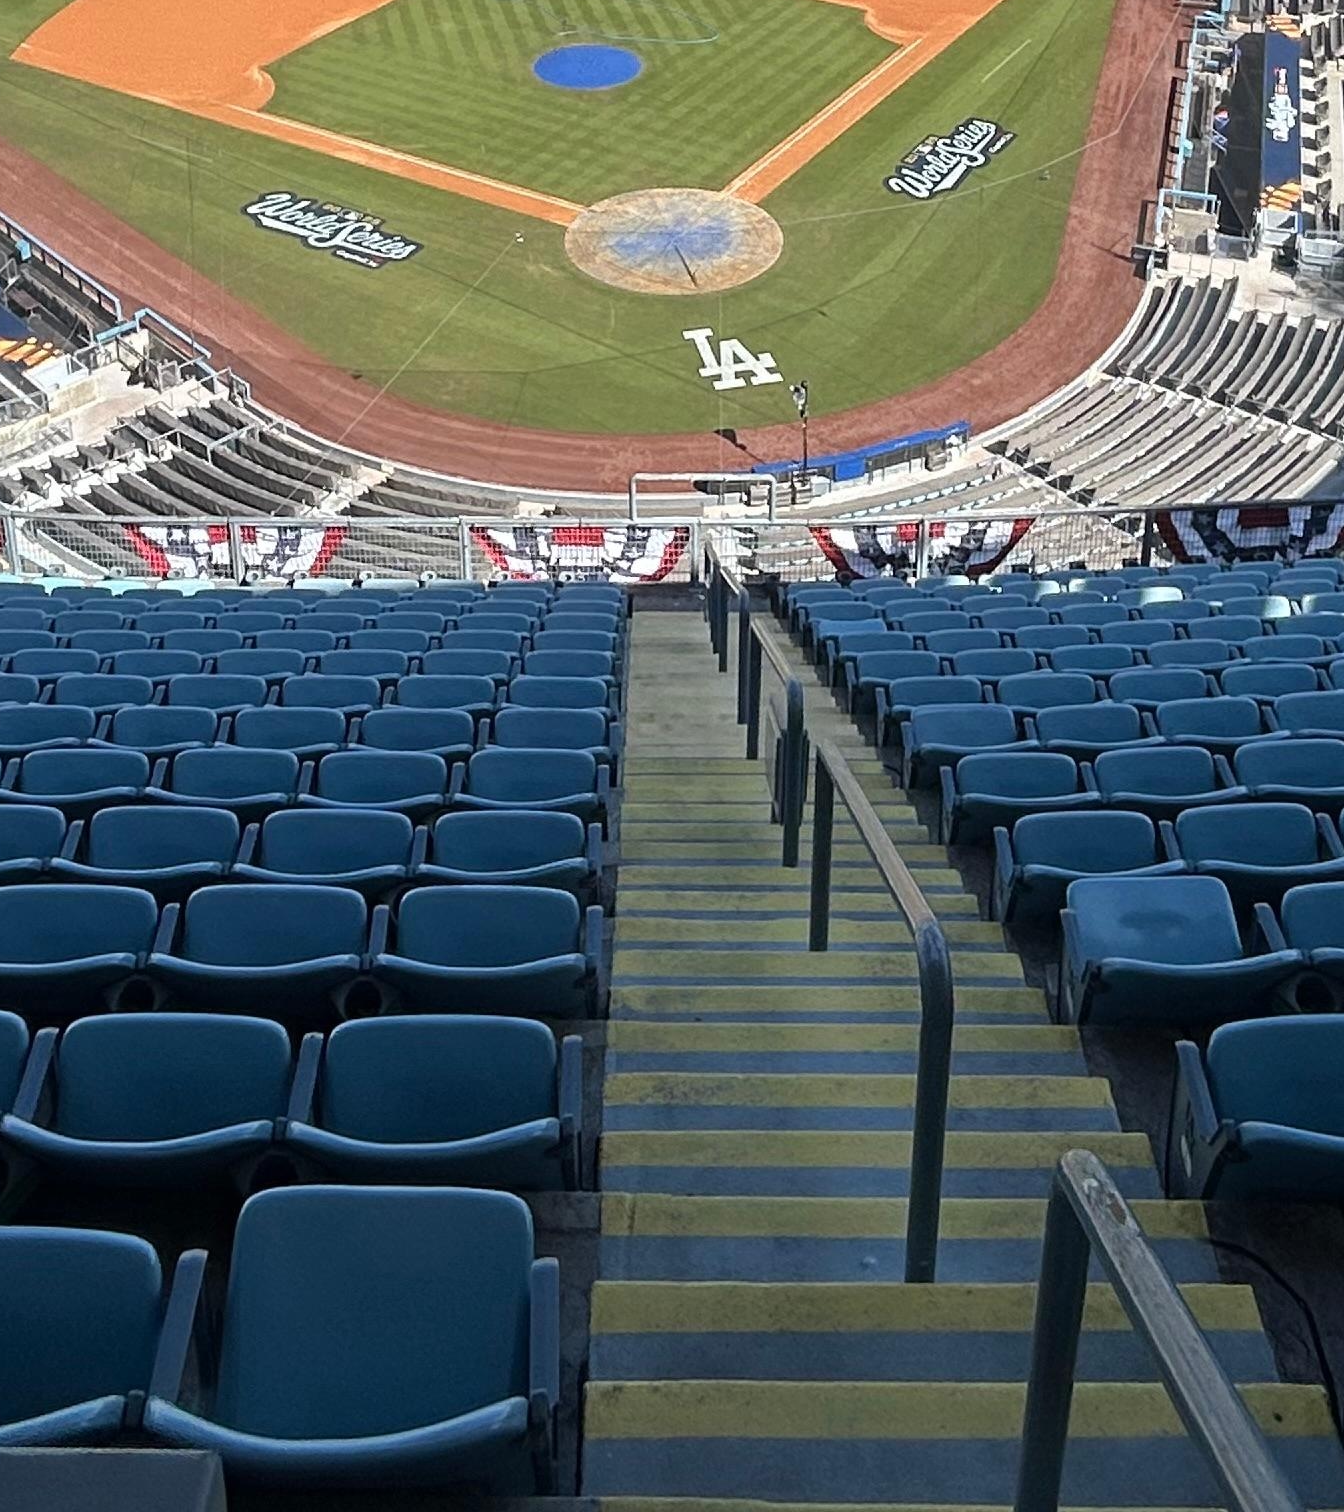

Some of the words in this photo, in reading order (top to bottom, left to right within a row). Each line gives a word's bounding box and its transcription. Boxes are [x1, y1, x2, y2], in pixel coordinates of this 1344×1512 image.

[888, 148, 960, 199] World
[936, 120, 997, 166] Series
[247, 193, 342, 238] World
[308, 221, 416, 259] Series
[682, 328, 784, 390] LA
